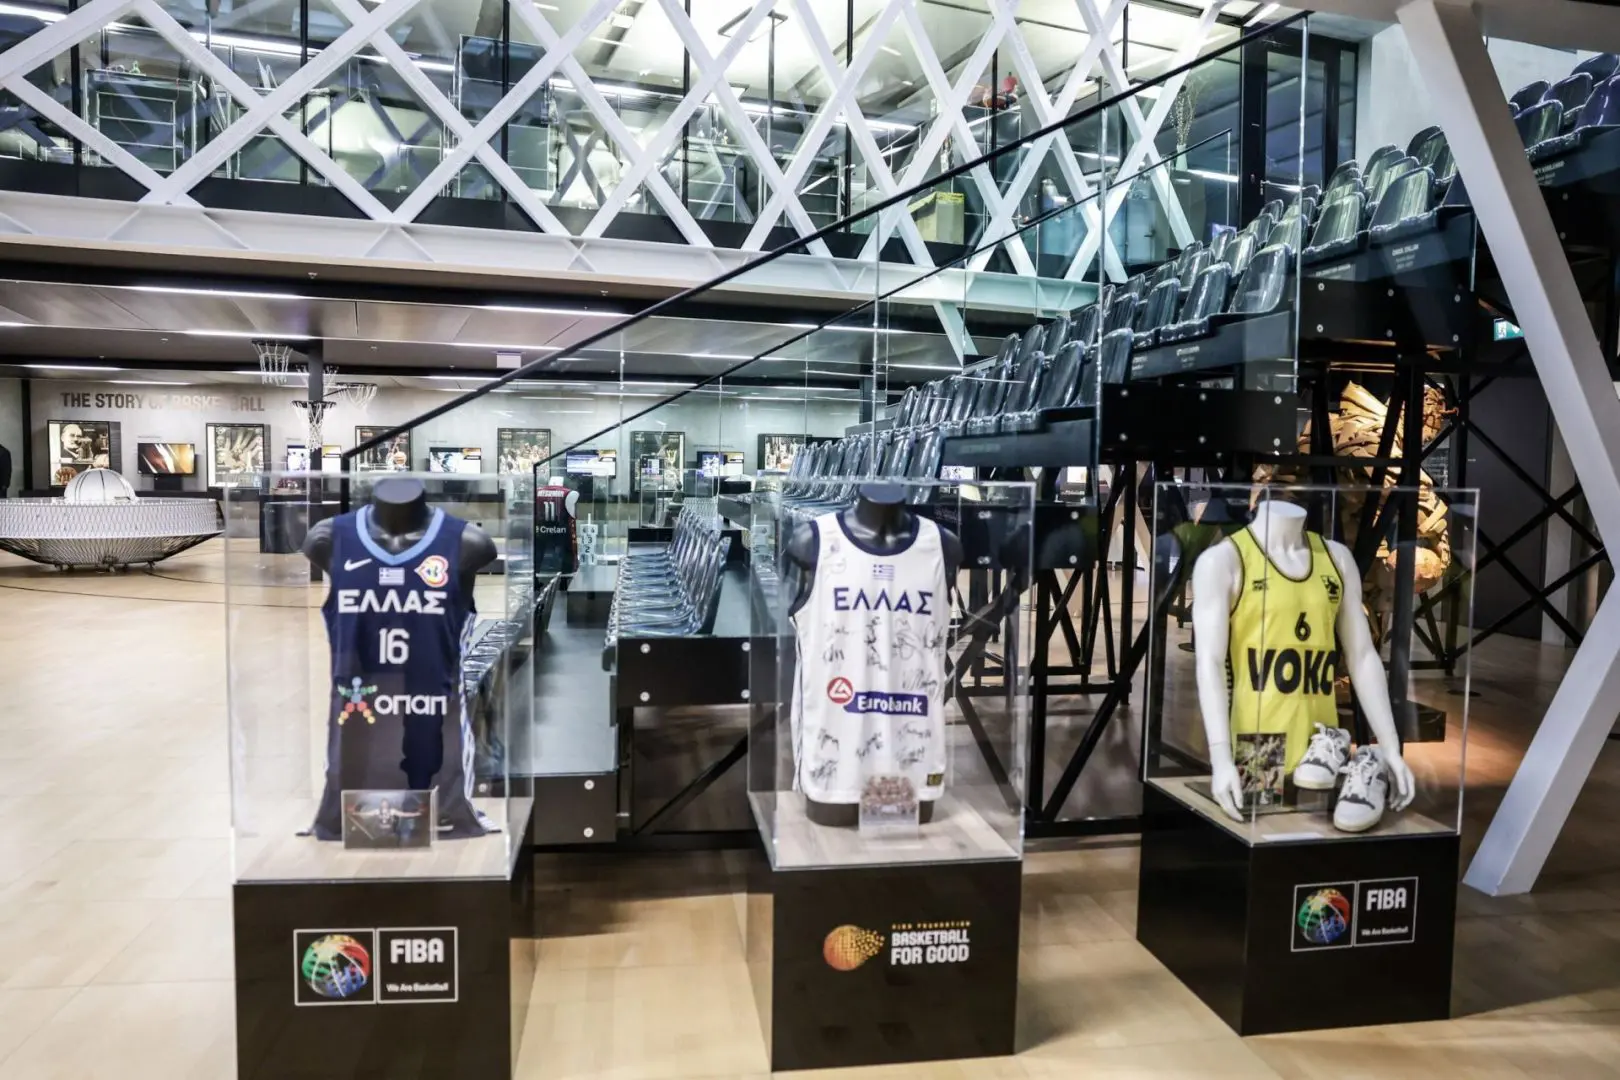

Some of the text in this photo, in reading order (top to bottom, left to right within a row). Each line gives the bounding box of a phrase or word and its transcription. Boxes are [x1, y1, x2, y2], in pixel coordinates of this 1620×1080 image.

[61, 392, 91, 408] THE
[95, 393, 145, 409] STORY
[337, 588, 447, 615] ΕΛΛΑΣ
[833, 587, 933, 616] ΕΛΛΑΣ
[1294, 612, 1311, 642] 6
[379, 628, 410, 664] 16
[1366, 887, 1407, 911] FIBA
[390, 937, 445, 964] FIBA
[891, 929, 970, 947] BASKETBALL
[891, 944, 970, 965] FOR GOOD
